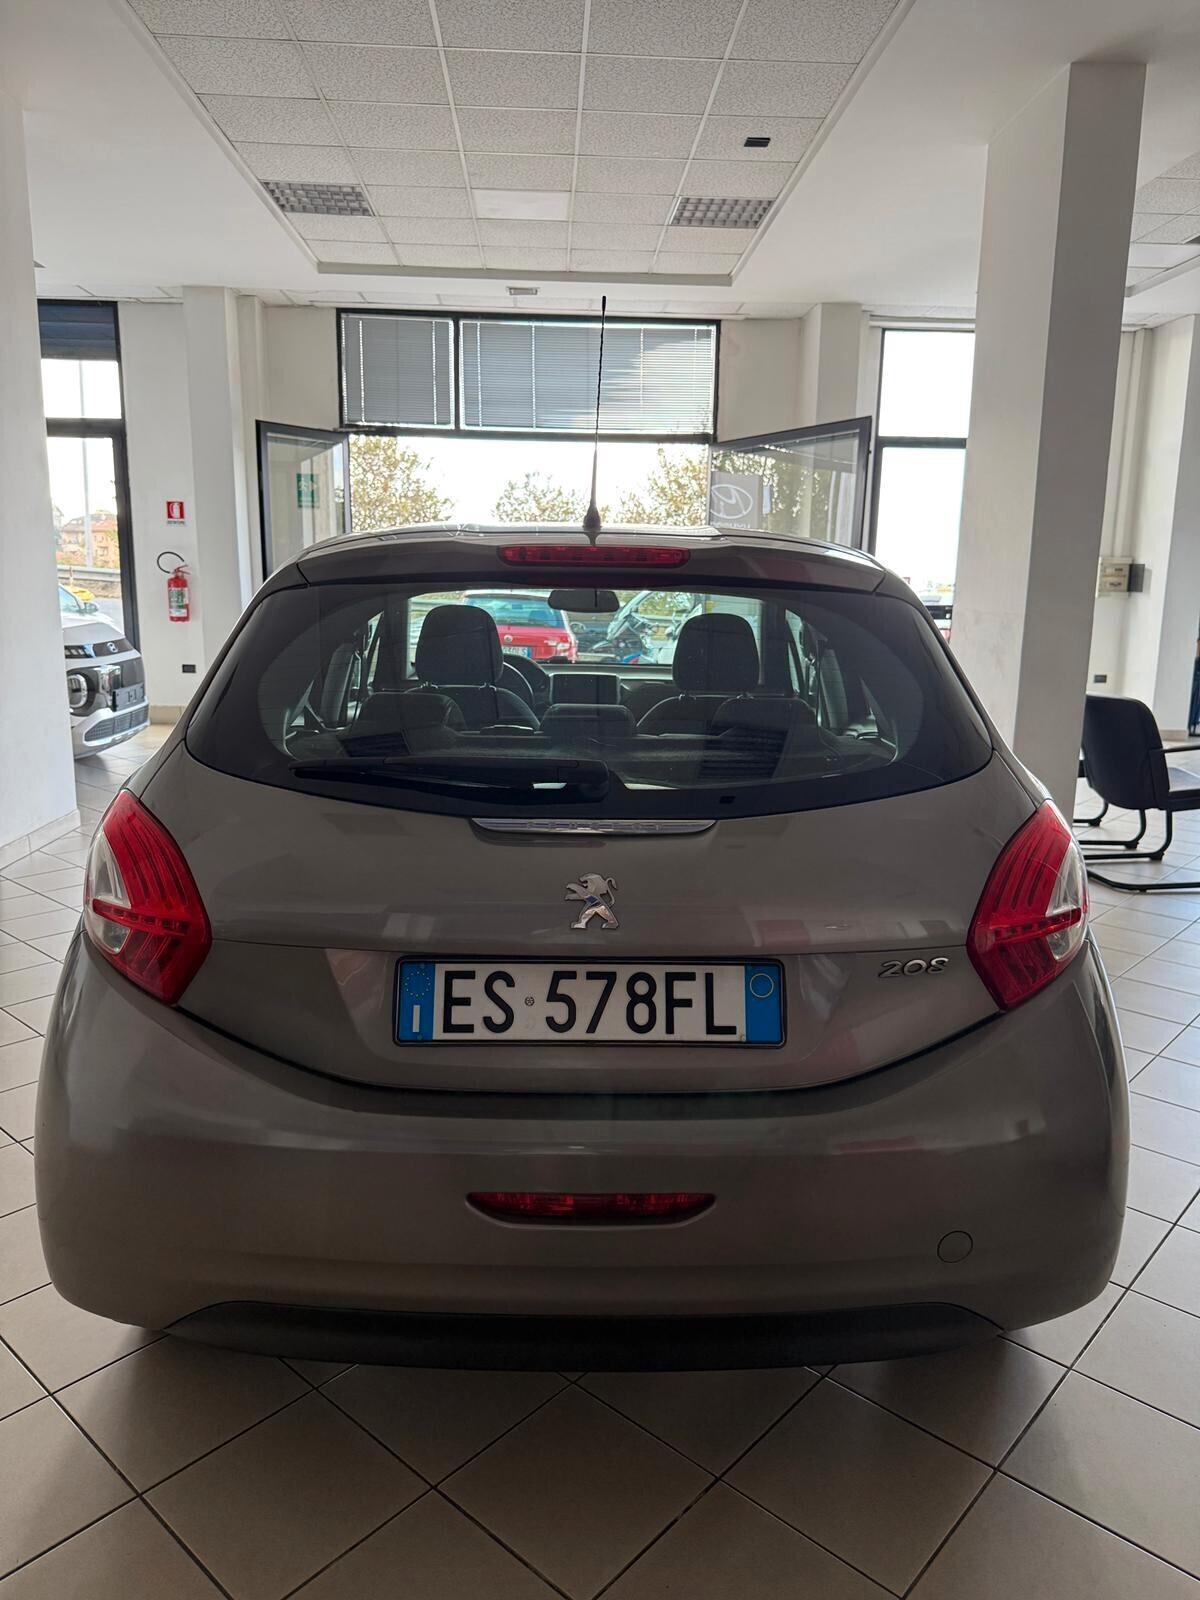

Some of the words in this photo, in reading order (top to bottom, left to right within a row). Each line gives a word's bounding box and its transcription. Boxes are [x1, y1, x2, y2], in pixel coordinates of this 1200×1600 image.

[878, 956, 950, 978] 208
[442, 970, 516, 1034] ES
[545, 970, 737, 1035] 578FL
